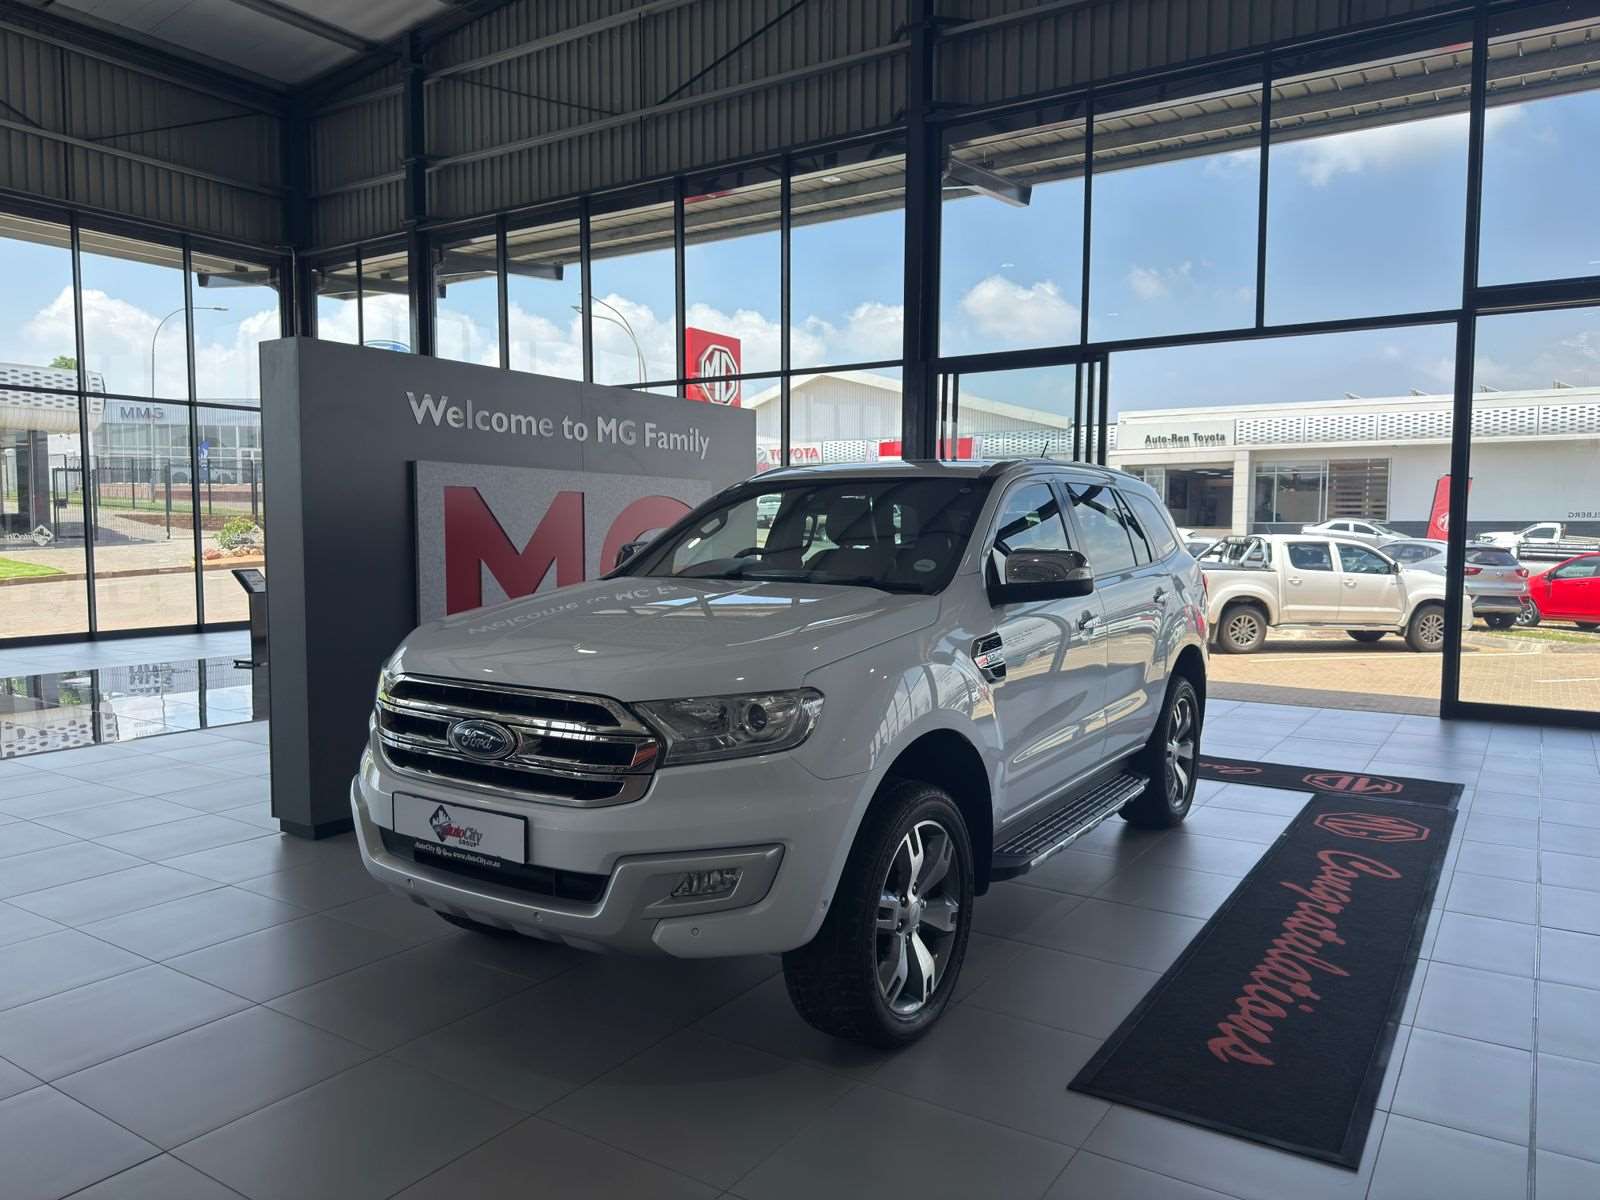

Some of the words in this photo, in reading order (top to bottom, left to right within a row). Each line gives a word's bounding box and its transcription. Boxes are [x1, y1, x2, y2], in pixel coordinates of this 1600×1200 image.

[705, 349, 737, 404] MG
[406, 391, 554, 437] Welcome
[562, 416, 588, 442] to
[597, 416, 637, 446] MG
[644, 422, 710, 460] Family
[1144, 433, 1190, 445] Auto-Ren
[1192, 432, 1226, 443] Toyota
[461, 729, 494, 750] Ford
[1207, 850, 1403, 1066] Congratulations
